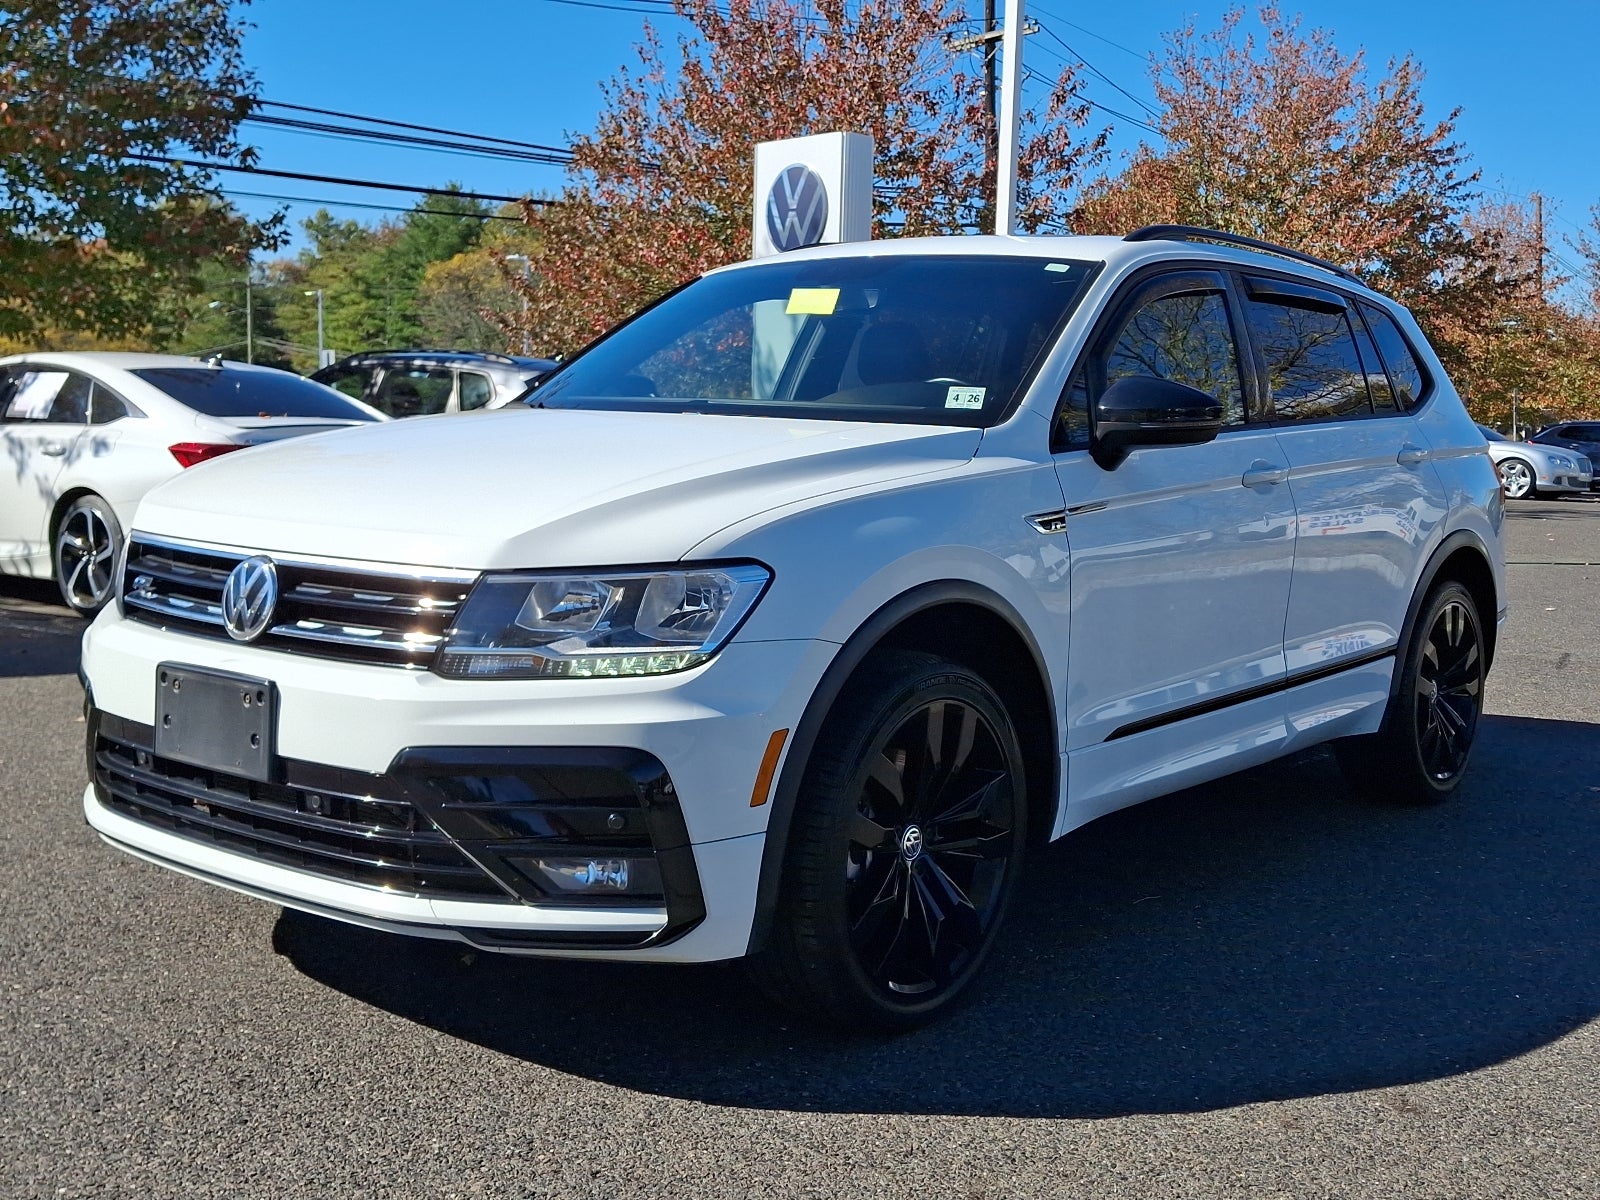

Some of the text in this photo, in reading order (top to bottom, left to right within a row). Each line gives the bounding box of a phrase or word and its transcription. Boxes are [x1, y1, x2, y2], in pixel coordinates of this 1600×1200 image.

[952, 393, 980, 403] 4 26
[223, 555, 278, 641] VW
